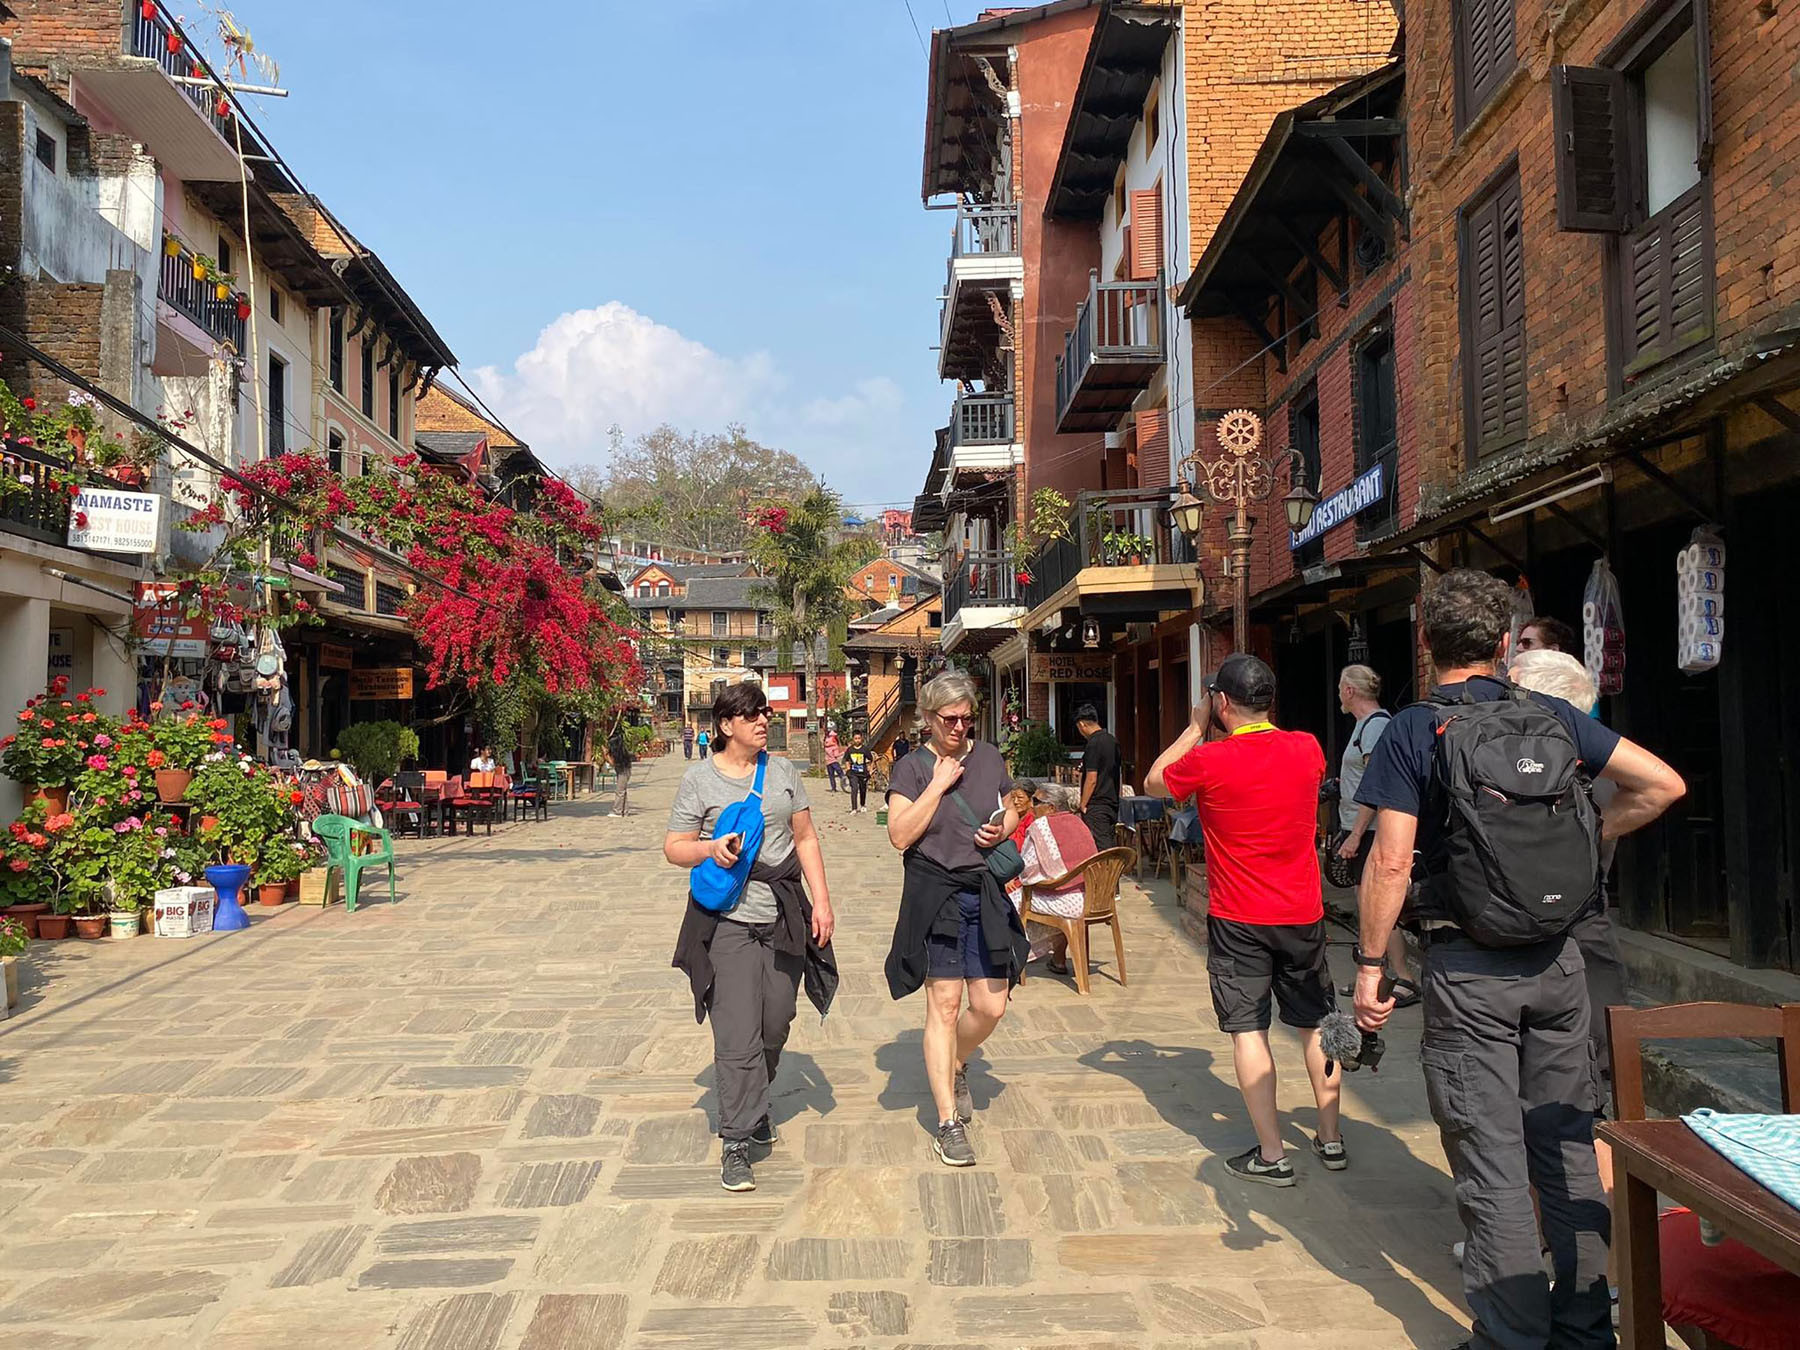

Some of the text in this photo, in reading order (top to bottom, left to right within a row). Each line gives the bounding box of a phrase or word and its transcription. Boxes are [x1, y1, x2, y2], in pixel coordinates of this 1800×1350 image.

[78, 494, 153, 512] NAMASTE
[1316, 469, 1380, 533] RESTAURANT
[116, 519, 153, 535] HOUSE
[1049, 656, 1075, 666] HOTEL
[1049, 667, 1113, 679] RED ROSE
[166, 906, 185, 916] BIG
[198, 900, 210, 911] BIG
